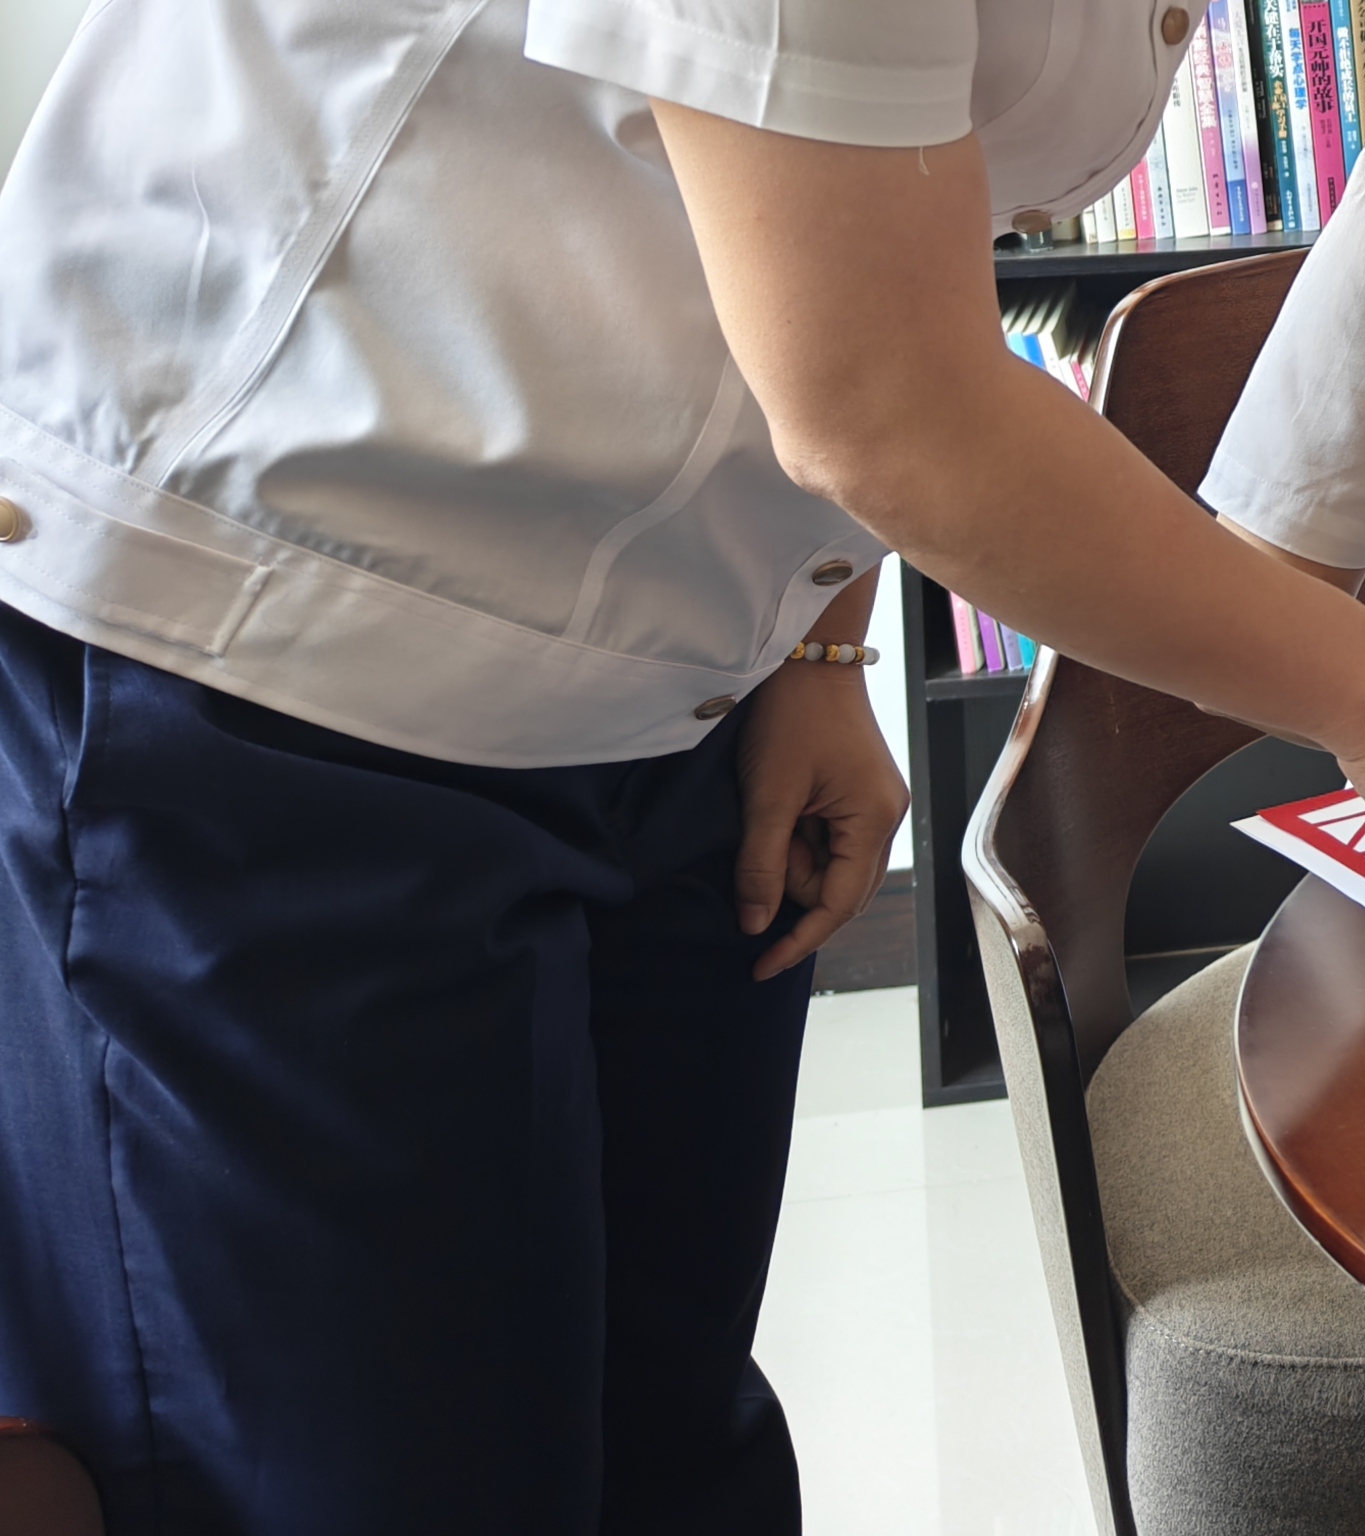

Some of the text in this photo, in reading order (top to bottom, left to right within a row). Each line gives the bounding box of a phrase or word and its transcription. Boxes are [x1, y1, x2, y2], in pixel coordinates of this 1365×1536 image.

[1308, 19, 1335, 115] 开国元帅的故事
